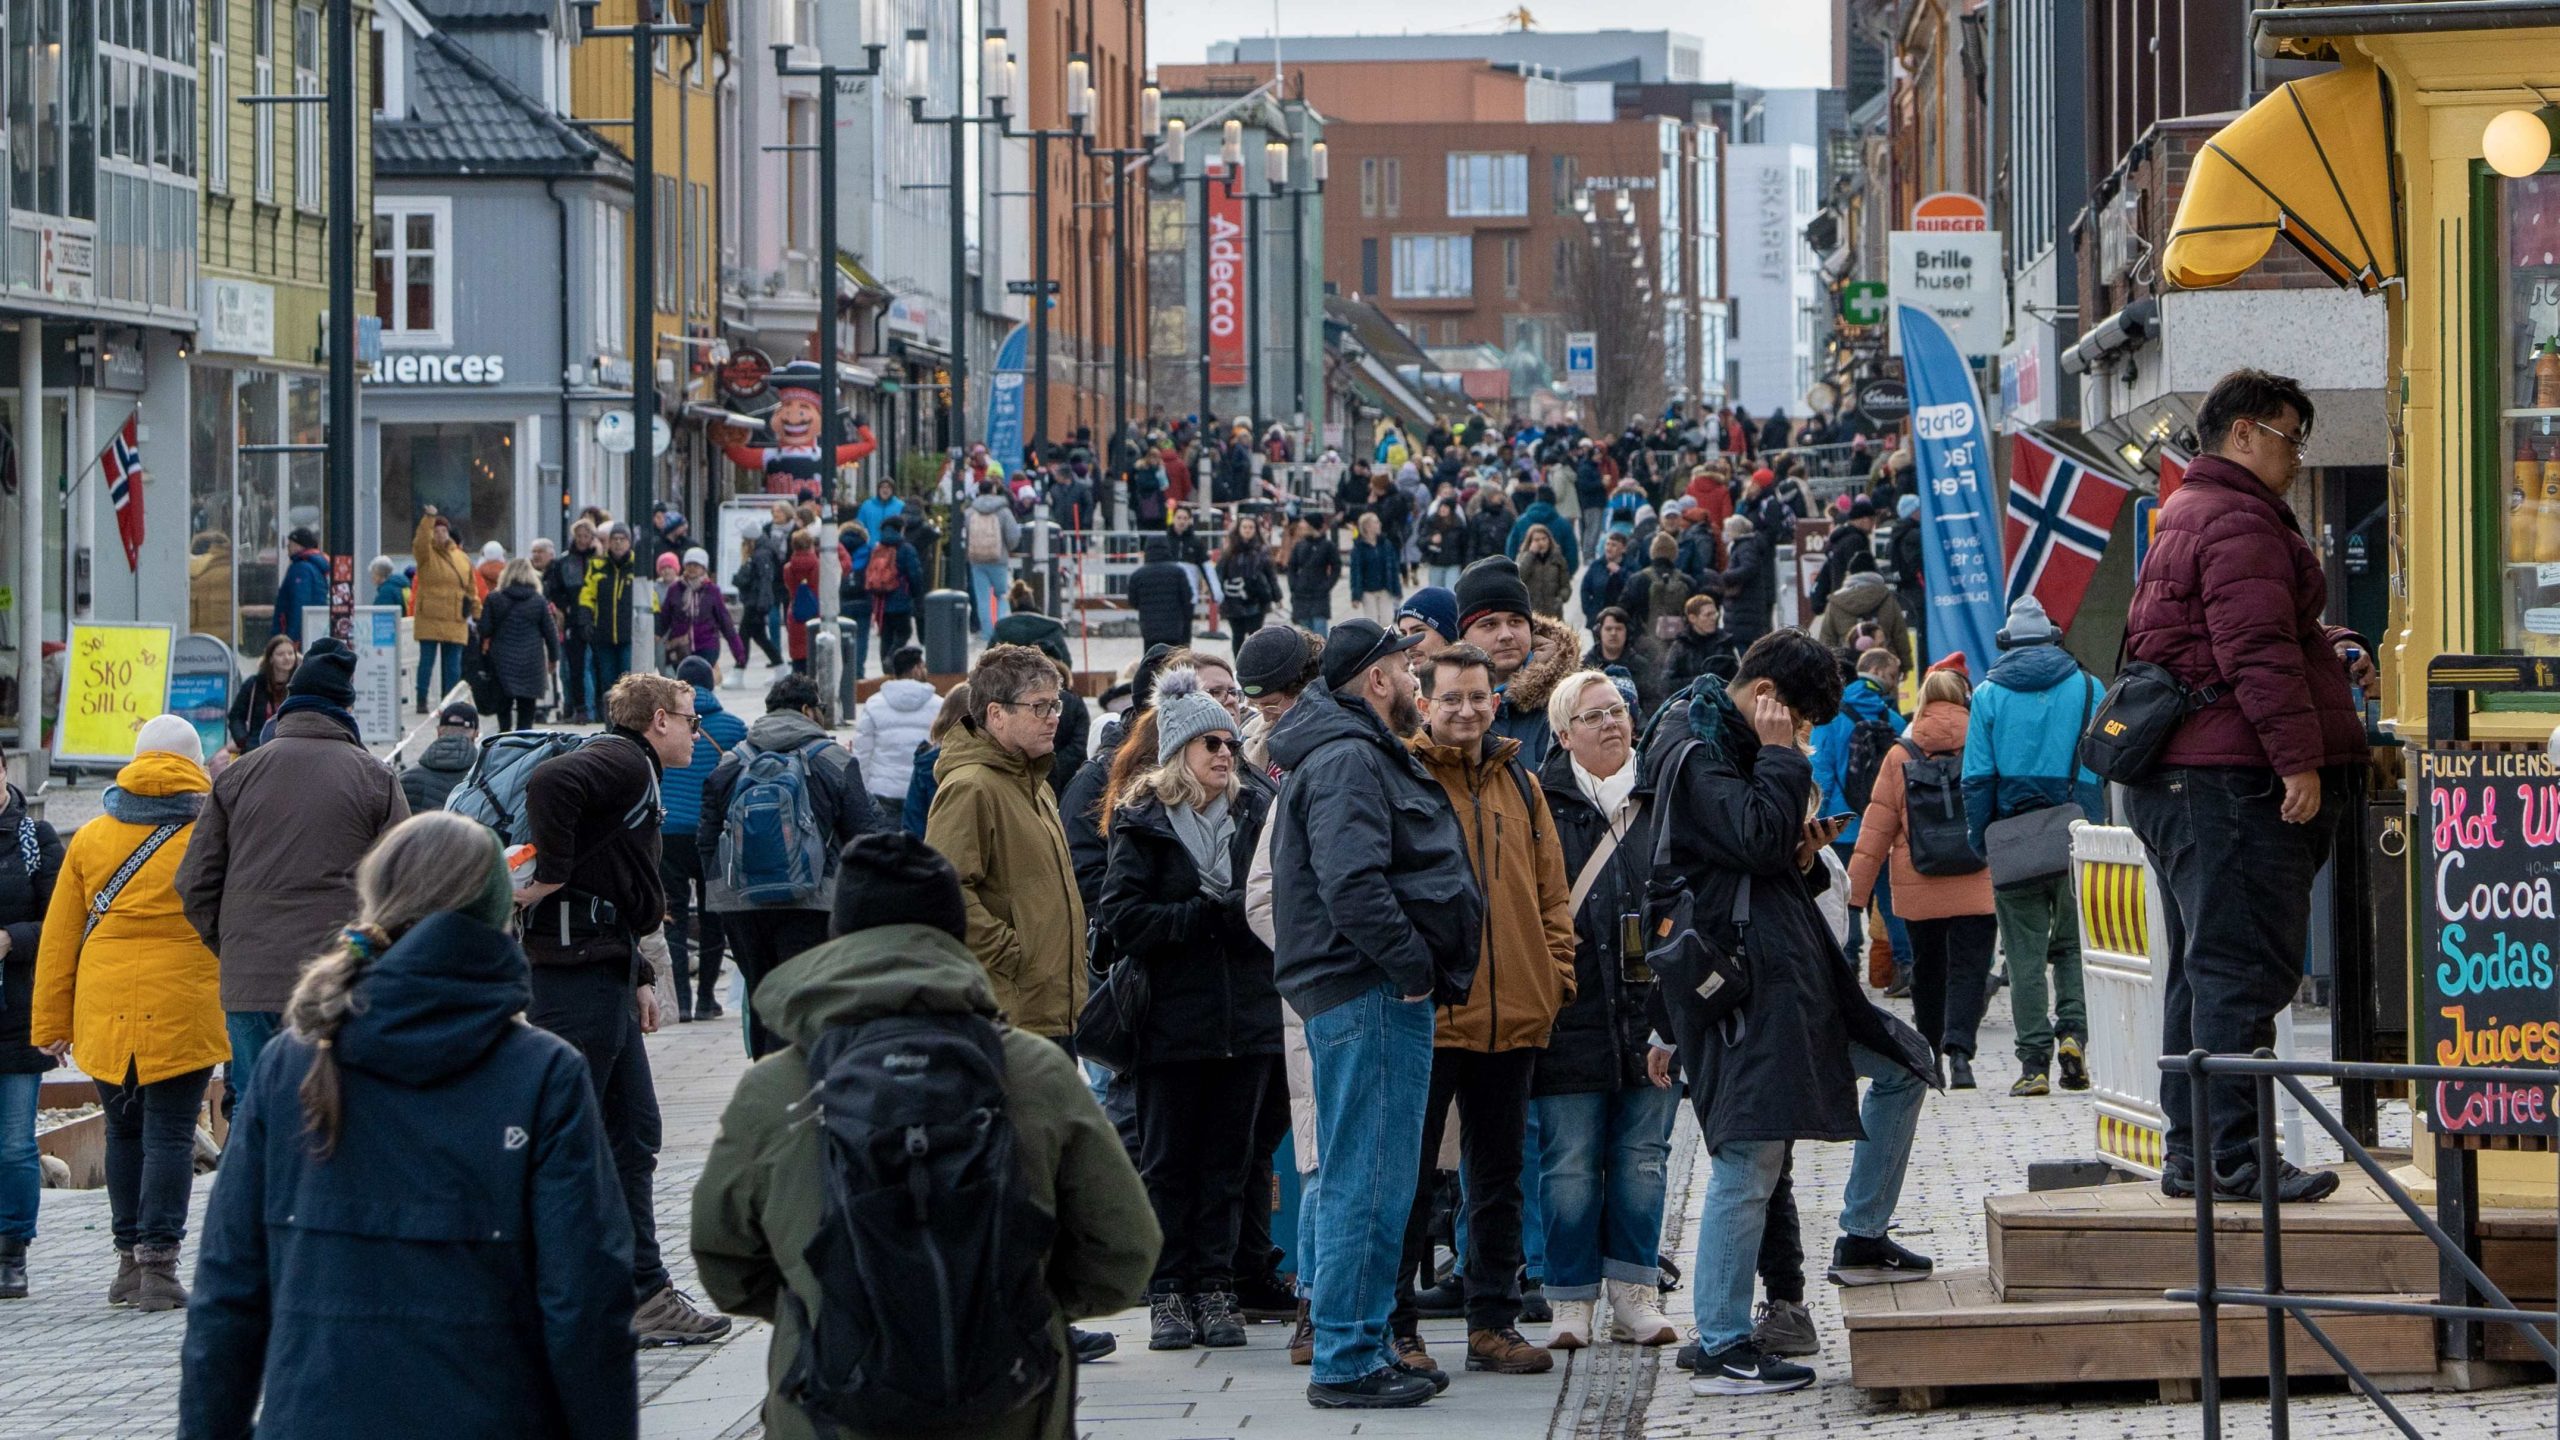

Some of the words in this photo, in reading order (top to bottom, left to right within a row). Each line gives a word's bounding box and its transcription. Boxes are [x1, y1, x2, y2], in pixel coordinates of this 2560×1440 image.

[1916, 219, 1986, 231] BURGER
[1209, 213, 1241, 337] Adecco
[1915, 251, 1973, 269] Brille
[1915, 271, 1972, 289] huset
[84, 659, 132, 690] SKO
[2104, 719, 2125, 737] CAT
[2420, 752, 2477, 778] FULLY
[2431, 785, 2505, 852] Hot
[2436, 849, 2556, 922] Cocoa
[2436, 922, 2554, 997] Sodas
[2436, 1004, 2560, 1068] Juices
[2435, 1065, 2547, 1131] Coffee
